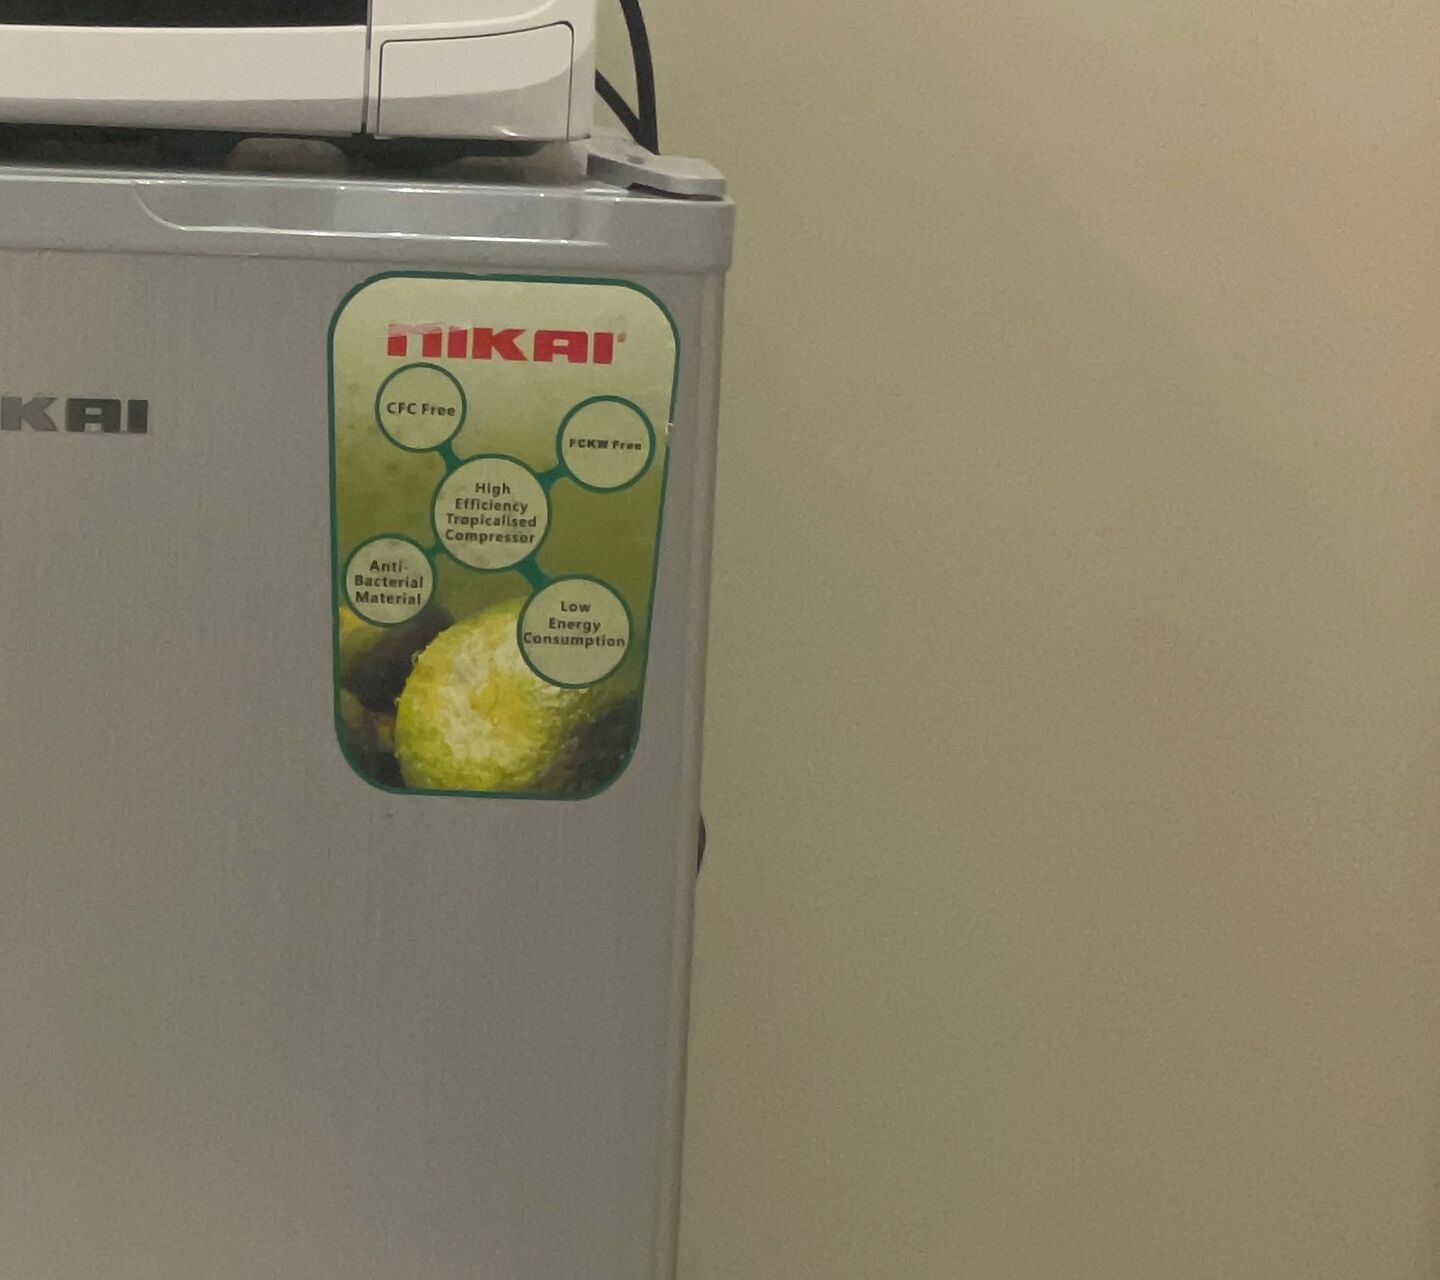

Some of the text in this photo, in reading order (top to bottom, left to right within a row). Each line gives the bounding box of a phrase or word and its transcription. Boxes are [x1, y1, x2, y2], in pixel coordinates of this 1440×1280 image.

[386, 401, 456, 418] CFC Free
[568, 437, 642, 451] FCKW Free
[474, 482, 511, 498] High
[454, 498, 529, 515] Efficiency
[446, 512, 537, 528] Tropicalised
[444, 528, 536, 545] Compressor
[369, 559, 409, 573] Anti-
[354, 574, 424, 589] Bacterial
[355, 591, 422, 606] Material
[560, 600, 591, 613] Low
[548, 616, 601, 633] Energy
[522, 632, 626, 648] Consumption
